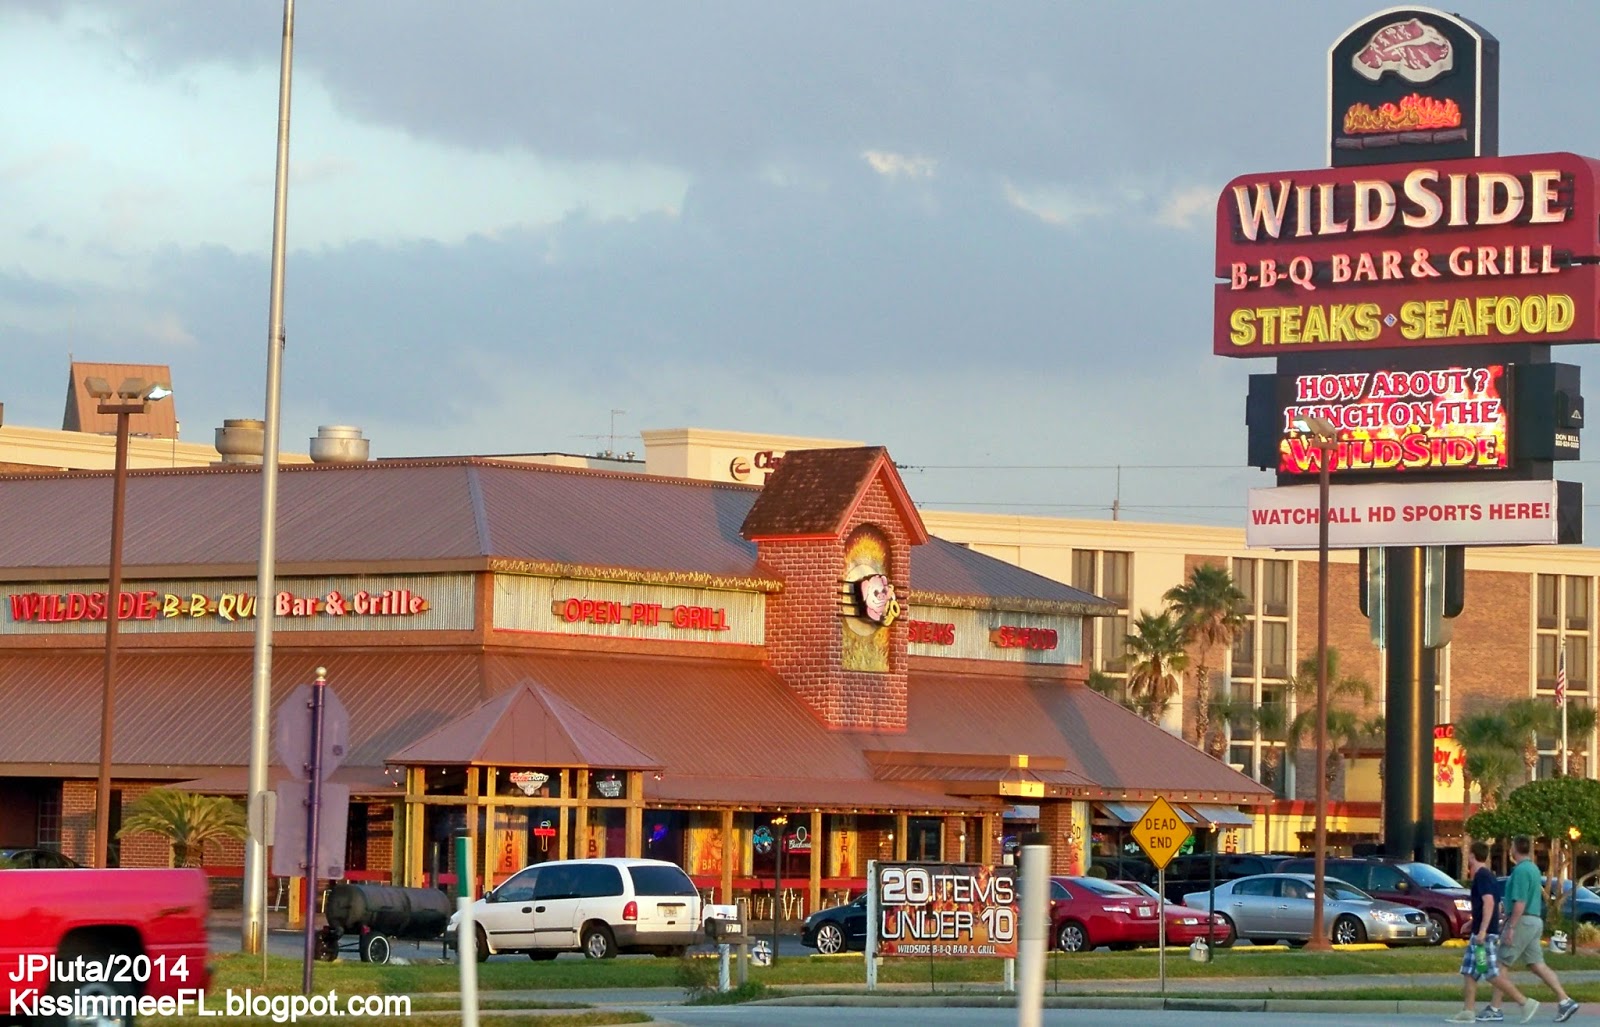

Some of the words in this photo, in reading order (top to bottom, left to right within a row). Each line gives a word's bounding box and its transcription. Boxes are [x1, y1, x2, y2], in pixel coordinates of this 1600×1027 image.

[1233, 169, 1567, 241] WILDSIDE
[1230, 261, 1316, 291] B-B-Q
[1332, 251, 1404, 283] BAR
[1410, 248, 1441, 278] &
[1449, 244, 1561, 277] GRILL
[1230, 303, 1382, 346] STEAKS
[1400, 294, 1575, 340] SEAFOOD
[1297, 374, 1369, 401] HOW
[1368, 368, 1472, 398] ABOUT
[1388, 400, 1434, 428] ON
[1436, 398, 1501, 425] THE
[1252, 508, 1320, 525] WATCH
[1327, 507, 1361, 523] ALL
[1368, 506, 1396, 522] HD
[1402, 504, 1482, 522] SPORTS
[1489, 502, 1550, 520] HERE!
[163, 593, 257, 621] B-B-QU
[275, 591, 319, 616] Bar
[325, 591, 346, 615] &
[354, 590, 425, 615] Grille
[564, 598, 621, 624] OPEN
[631, 603, 662, 626] PIT
[674, 605, 730, 630] GRILL
[909, 619, 955, 645] STEAKS
[1000, 626, 1058, 650] SEAFOOD
[588, 808, 598, 858] RIB
[1145, 818, 1177, 831] DEAD
[1150, 836, 1173, 849] END
[881, 868, 930, 906] 20
[932, 875, 1013, 904] ITEMS
[882, 910, 973, 939] UNDER
[981, 906, 1014, 943] 10
[898, 945, 930, 954] WILDSIDE
[952, 945, 968, 954] BAR
[970, 945, 975, 954] &
[978, 945, 996, 955] GRILL
